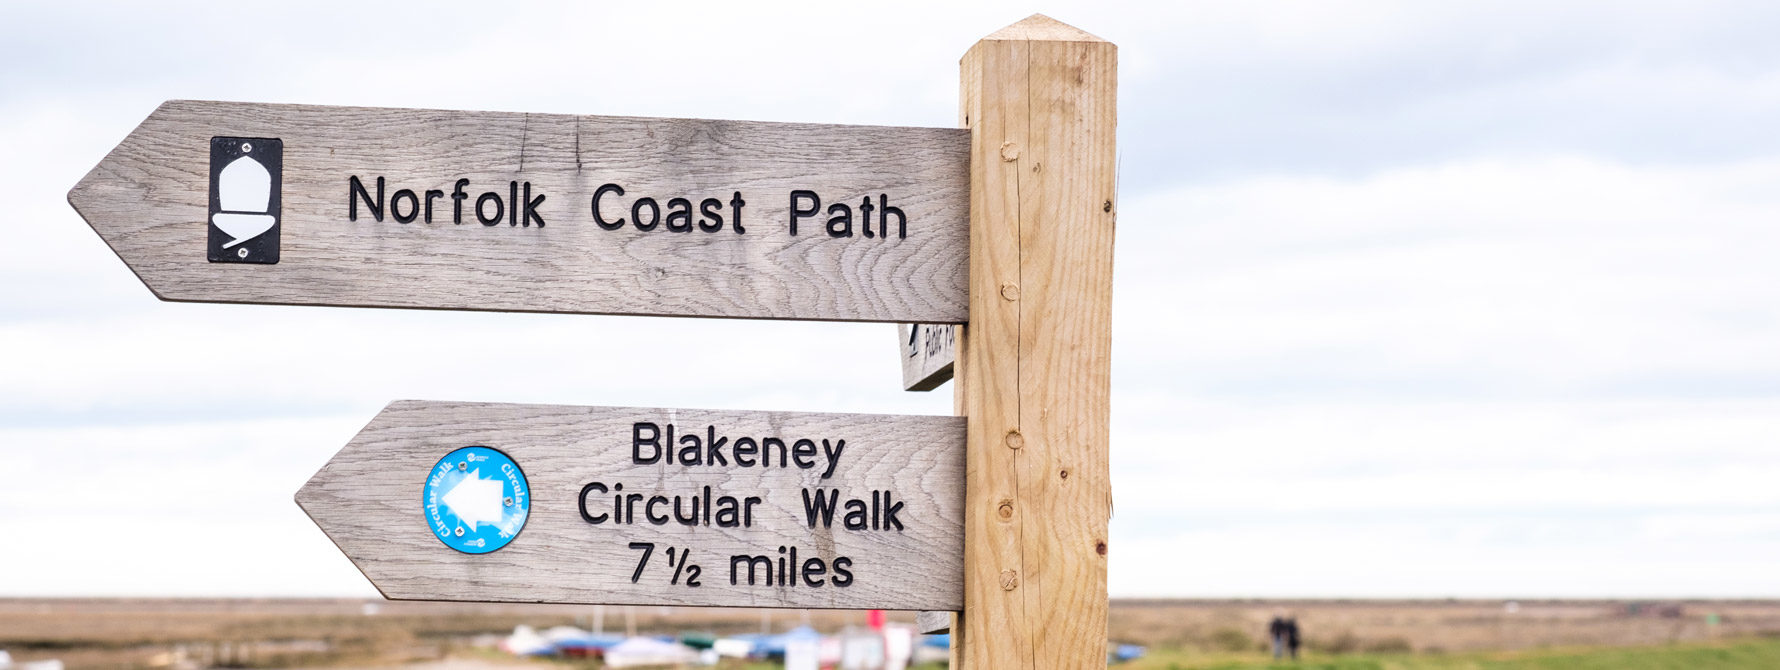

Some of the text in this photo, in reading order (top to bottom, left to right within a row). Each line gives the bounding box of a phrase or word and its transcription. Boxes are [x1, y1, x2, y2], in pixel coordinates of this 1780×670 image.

[349, 174, 907, 240] Norfolk Coast Path
[632, 422, 846, 480] Blakeney
[427, 462, 454, 538] Circular Walk
[501, 463, 525, 511] Circular
[578, 481, 905, 532] Circular Walk
[730, 545, 854, 588] miles
